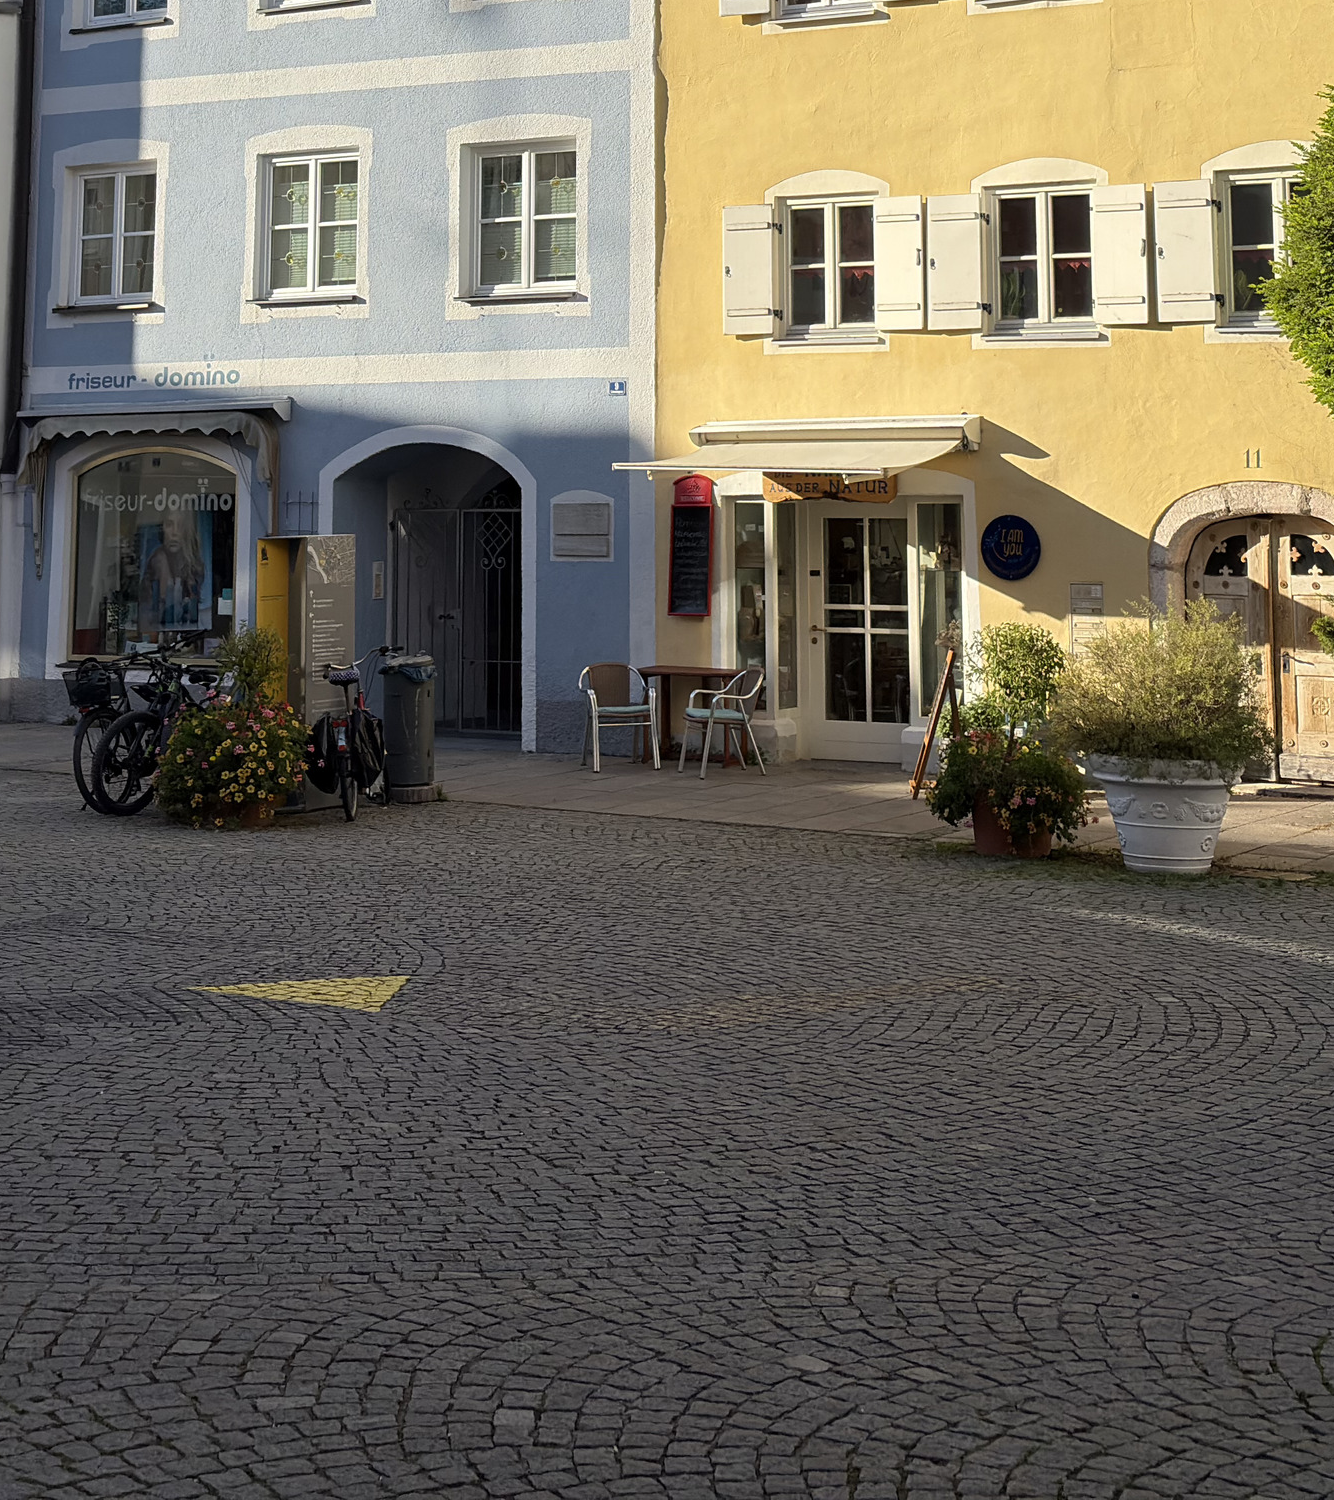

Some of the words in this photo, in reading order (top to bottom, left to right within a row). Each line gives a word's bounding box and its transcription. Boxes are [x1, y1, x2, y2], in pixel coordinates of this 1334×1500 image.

[67, 372, 137, 390] friseur
[154, 361, 241, 388] domino
[1243, 447, 1263, 469] 11
[769, 482, 792, 493] AUS
[796, 482, 819, 493] DER
[829, 479, 889, 495] NATUR
